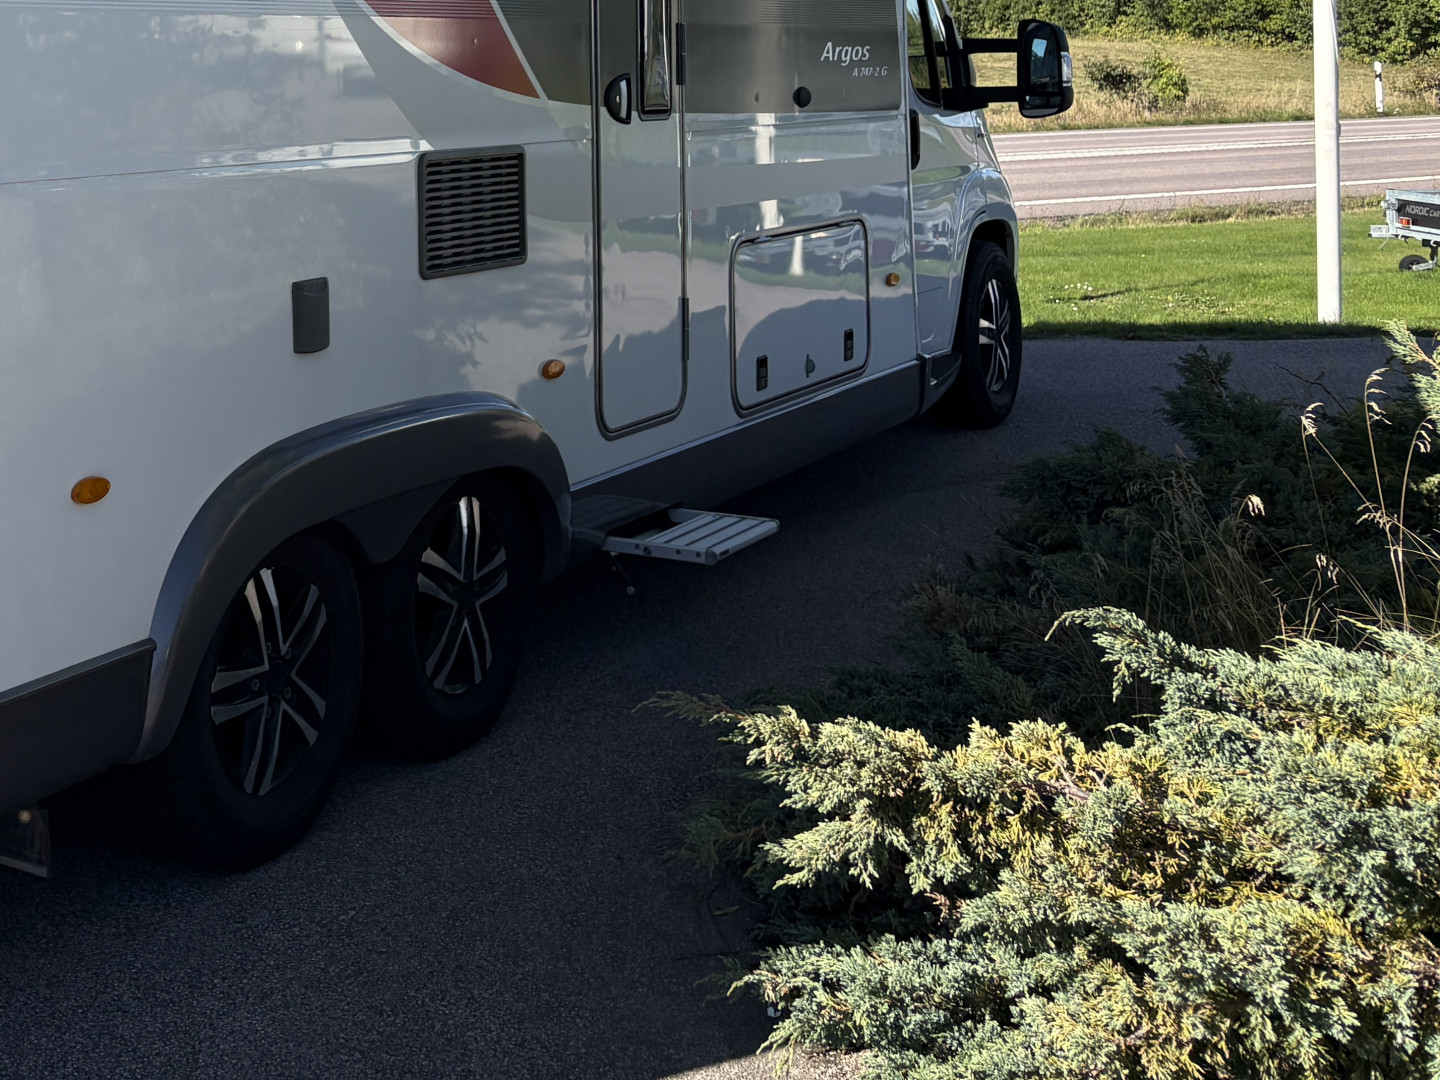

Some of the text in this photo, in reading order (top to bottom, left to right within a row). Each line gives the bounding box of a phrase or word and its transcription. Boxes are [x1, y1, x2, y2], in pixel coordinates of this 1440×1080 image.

[820, 41, 871, 67] Argos
[851, 65, 888, 78] A 747-2 G
[1405, 204, 1440, 219] NORDIC CAR
